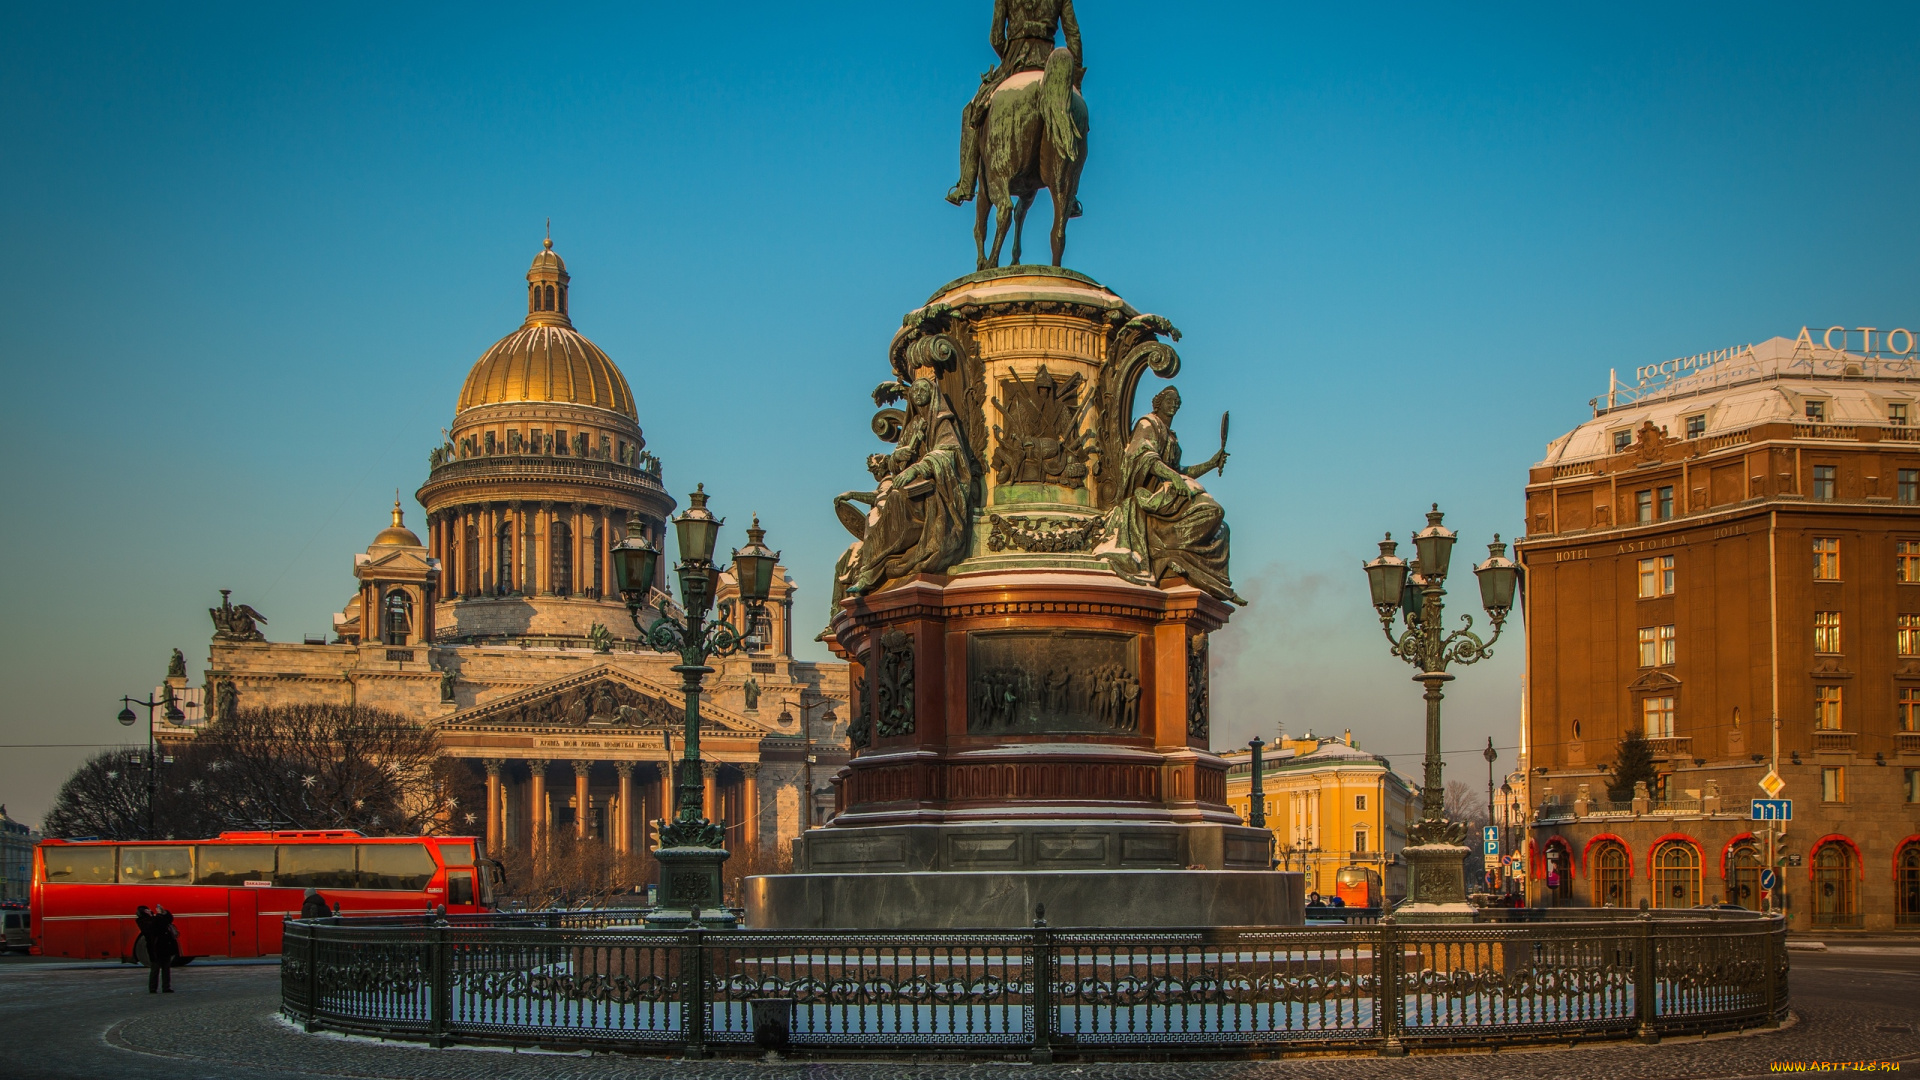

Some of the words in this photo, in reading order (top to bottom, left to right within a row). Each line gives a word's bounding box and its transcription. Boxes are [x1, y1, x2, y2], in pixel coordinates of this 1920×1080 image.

[1636, 343, 1755, 381] ГОСТИНИЦА
[1792, 325, 1914, 355] АСТО
[1556, 549, 1590, 562] HOTEL
[1616, 535, 1688, 554] ASTORIA
